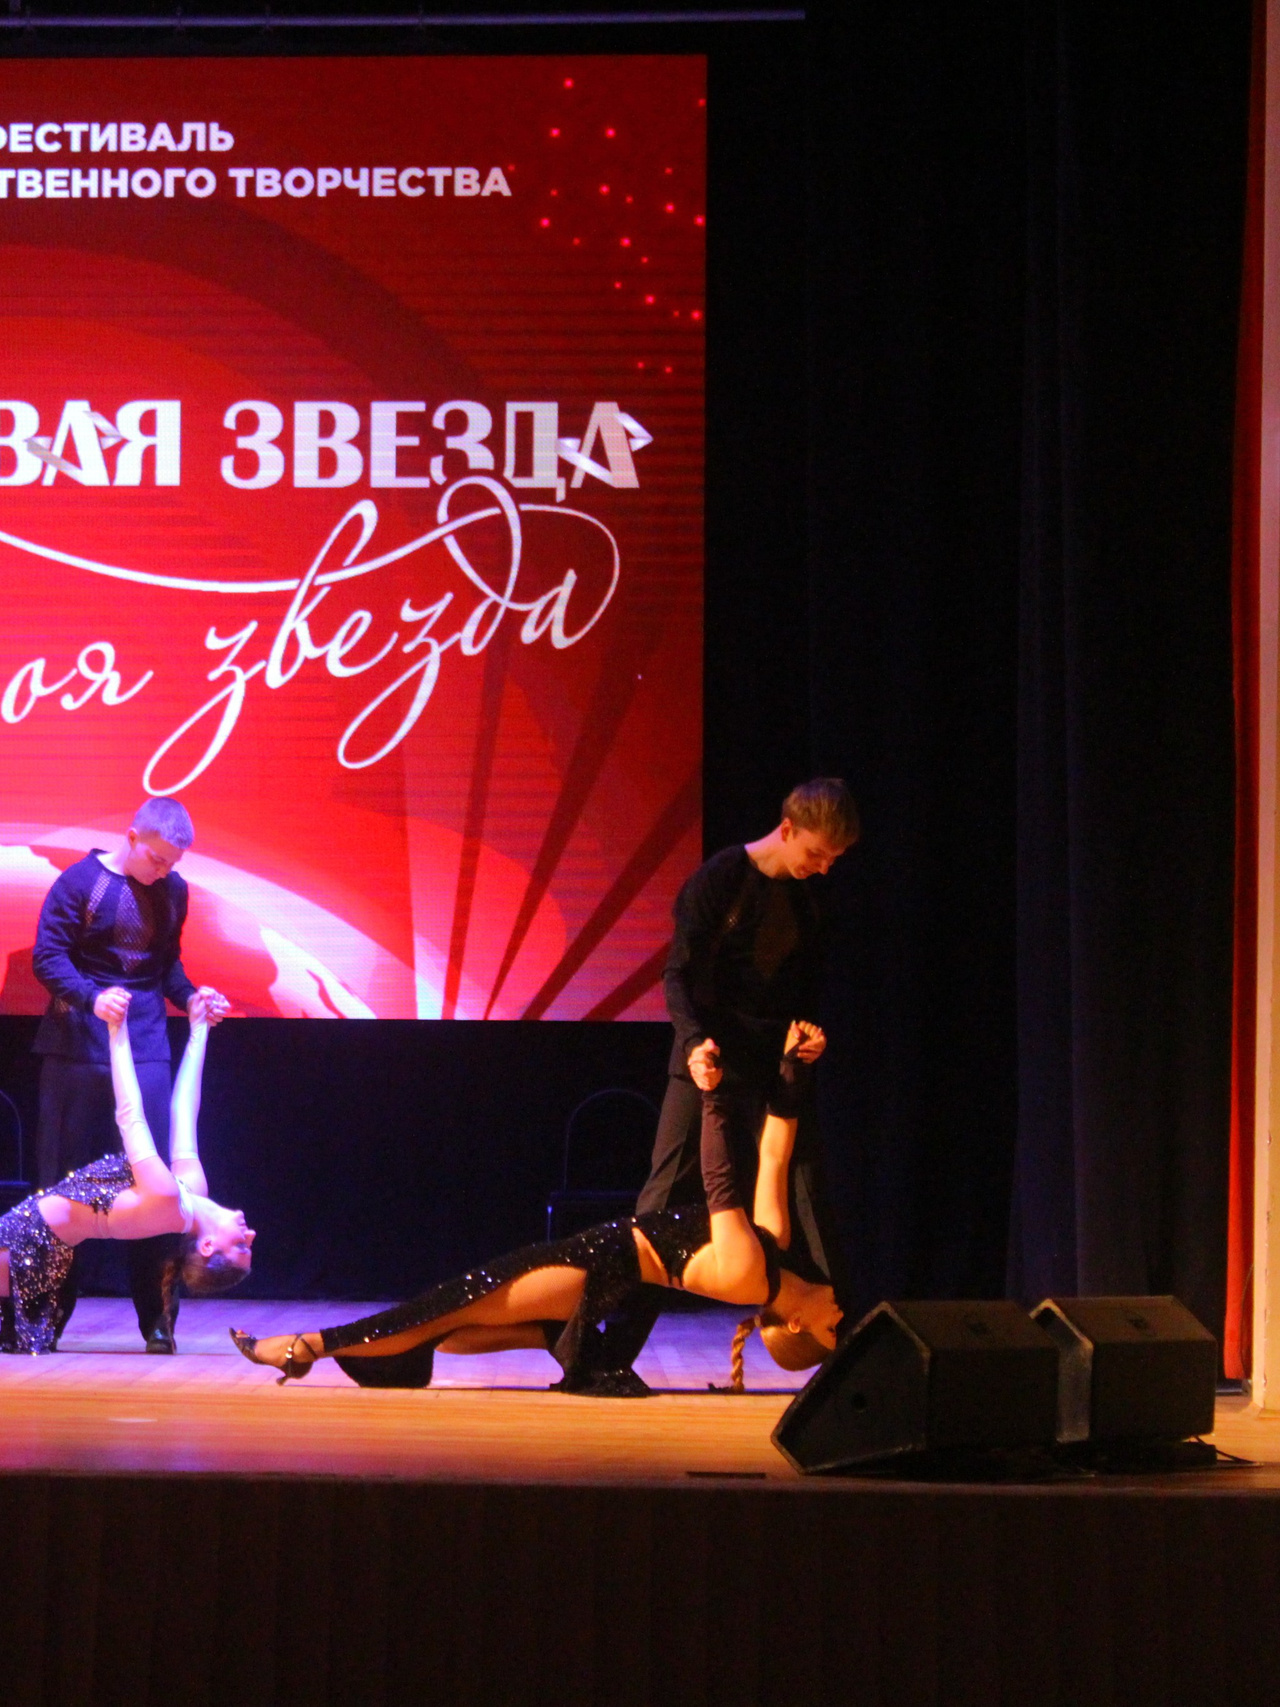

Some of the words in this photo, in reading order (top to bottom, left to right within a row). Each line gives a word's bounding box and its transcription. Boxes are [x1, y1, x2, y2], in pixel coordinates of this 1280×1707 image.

[228, 166, 512, 199] ТВОРЧЕСТВА
[220, 399, 654, 502] ЗВЕЗДА
[142, 474, 622, 797] звезда
